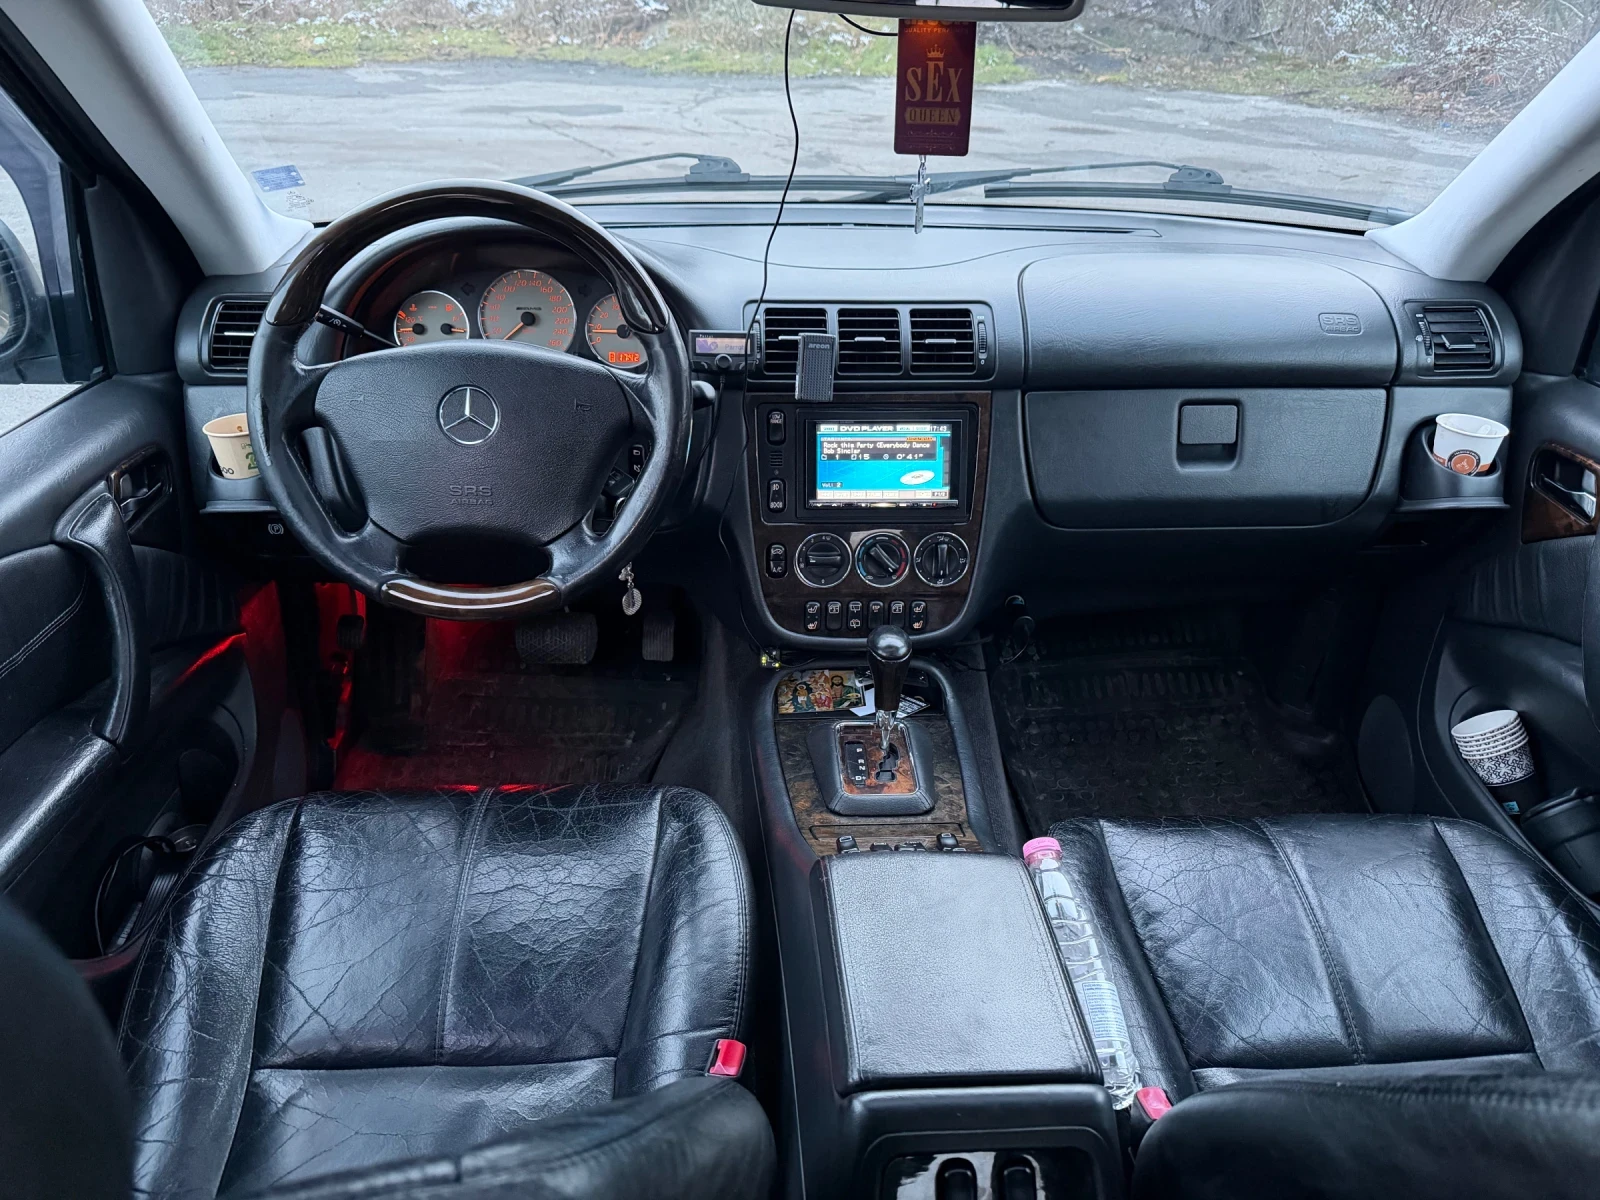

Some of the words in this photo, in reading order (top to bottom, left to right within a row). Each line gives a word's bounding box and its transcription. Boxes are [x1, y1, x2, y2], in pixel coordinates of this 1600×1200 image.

[905, 60, 963, 103] SEX
[909, 108, 956, 123] QUEEN
[552, 306, 568, 314] 200
[1322, 316, 1358, 325] SRS
[449, 485, 493, 496] SRS
